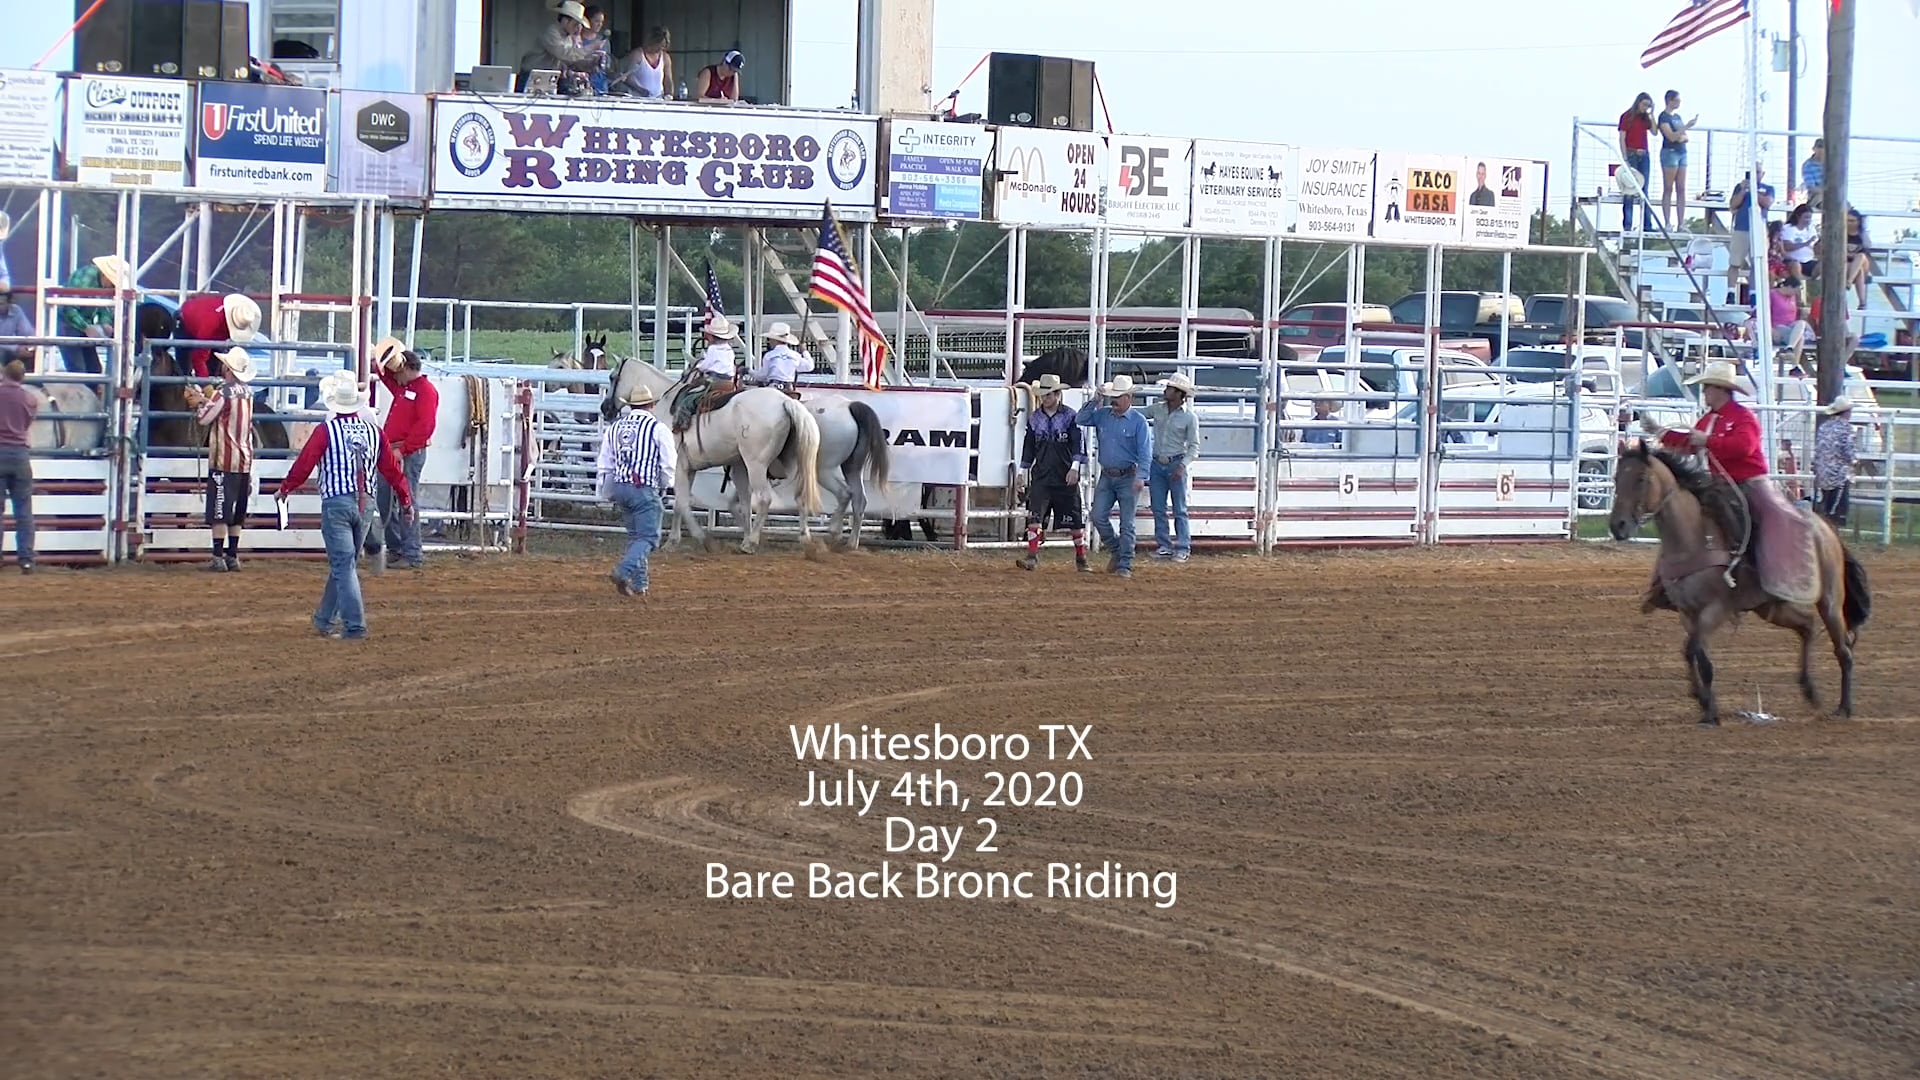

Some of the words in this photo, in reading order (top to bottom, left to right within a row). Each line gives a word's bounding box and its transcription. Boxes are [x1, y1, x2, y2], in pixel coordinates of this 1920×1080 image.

[130, 91, 180, 110] OUTPOST
[371, 112, 396, 127] DWC
[253, 133, 278, 146] SPEND
[279, 135, 293, 147] LIFE
[294, 136, 321, 148] WISELY
[503, 111, 821, 162] WHITESBORO
[923, 133, 976, 147] INTEGRITY
[1067, 143, 1094, 165] OPEN
[209, 163, 313, 182] firstunitedbank.com
[501, 149, 688, 190] RIDING
[696, 160, 815, 198] CLUB
[1219, 165, 1240, 179] HAYES
[1241, 166, 1264, 180] EQUINE
[1305, 158, 1330, 174] JOY
[1331, 159, 1367, 176] SMITH
[1010, 180, 1057, 194] McDonald's
[1074, 168, 1087, 189] 24
[1413, 170, 1451, 189] TACO
[1199, 184, 1245, 196] VETERINARY
[1247, 186, 1282, 198] SERVICES
[1301, 181, 1368, 198] INSURANCE
[1061, 191, 1097, 215] HOURS
[1167, 202, 1181, 211] LLC
[1298, 202, 1345, 216] Whitesboro,
[1346, 204, 1368, 217] Texas
[1413, 193, 1449, 212] CASA
[1308, 221, 1355, 233] 903-564-9131
[1404, 215, 1448, 227] WHITESBORO,
[1449, 217, 1457, 226] TX
[1475, 218, 1519, 229] 903.815.1113
[881, 428, 967, 448] AM
[1342, 474, 1354, 494] 5
[1500, 475, 1510, 495] 6
